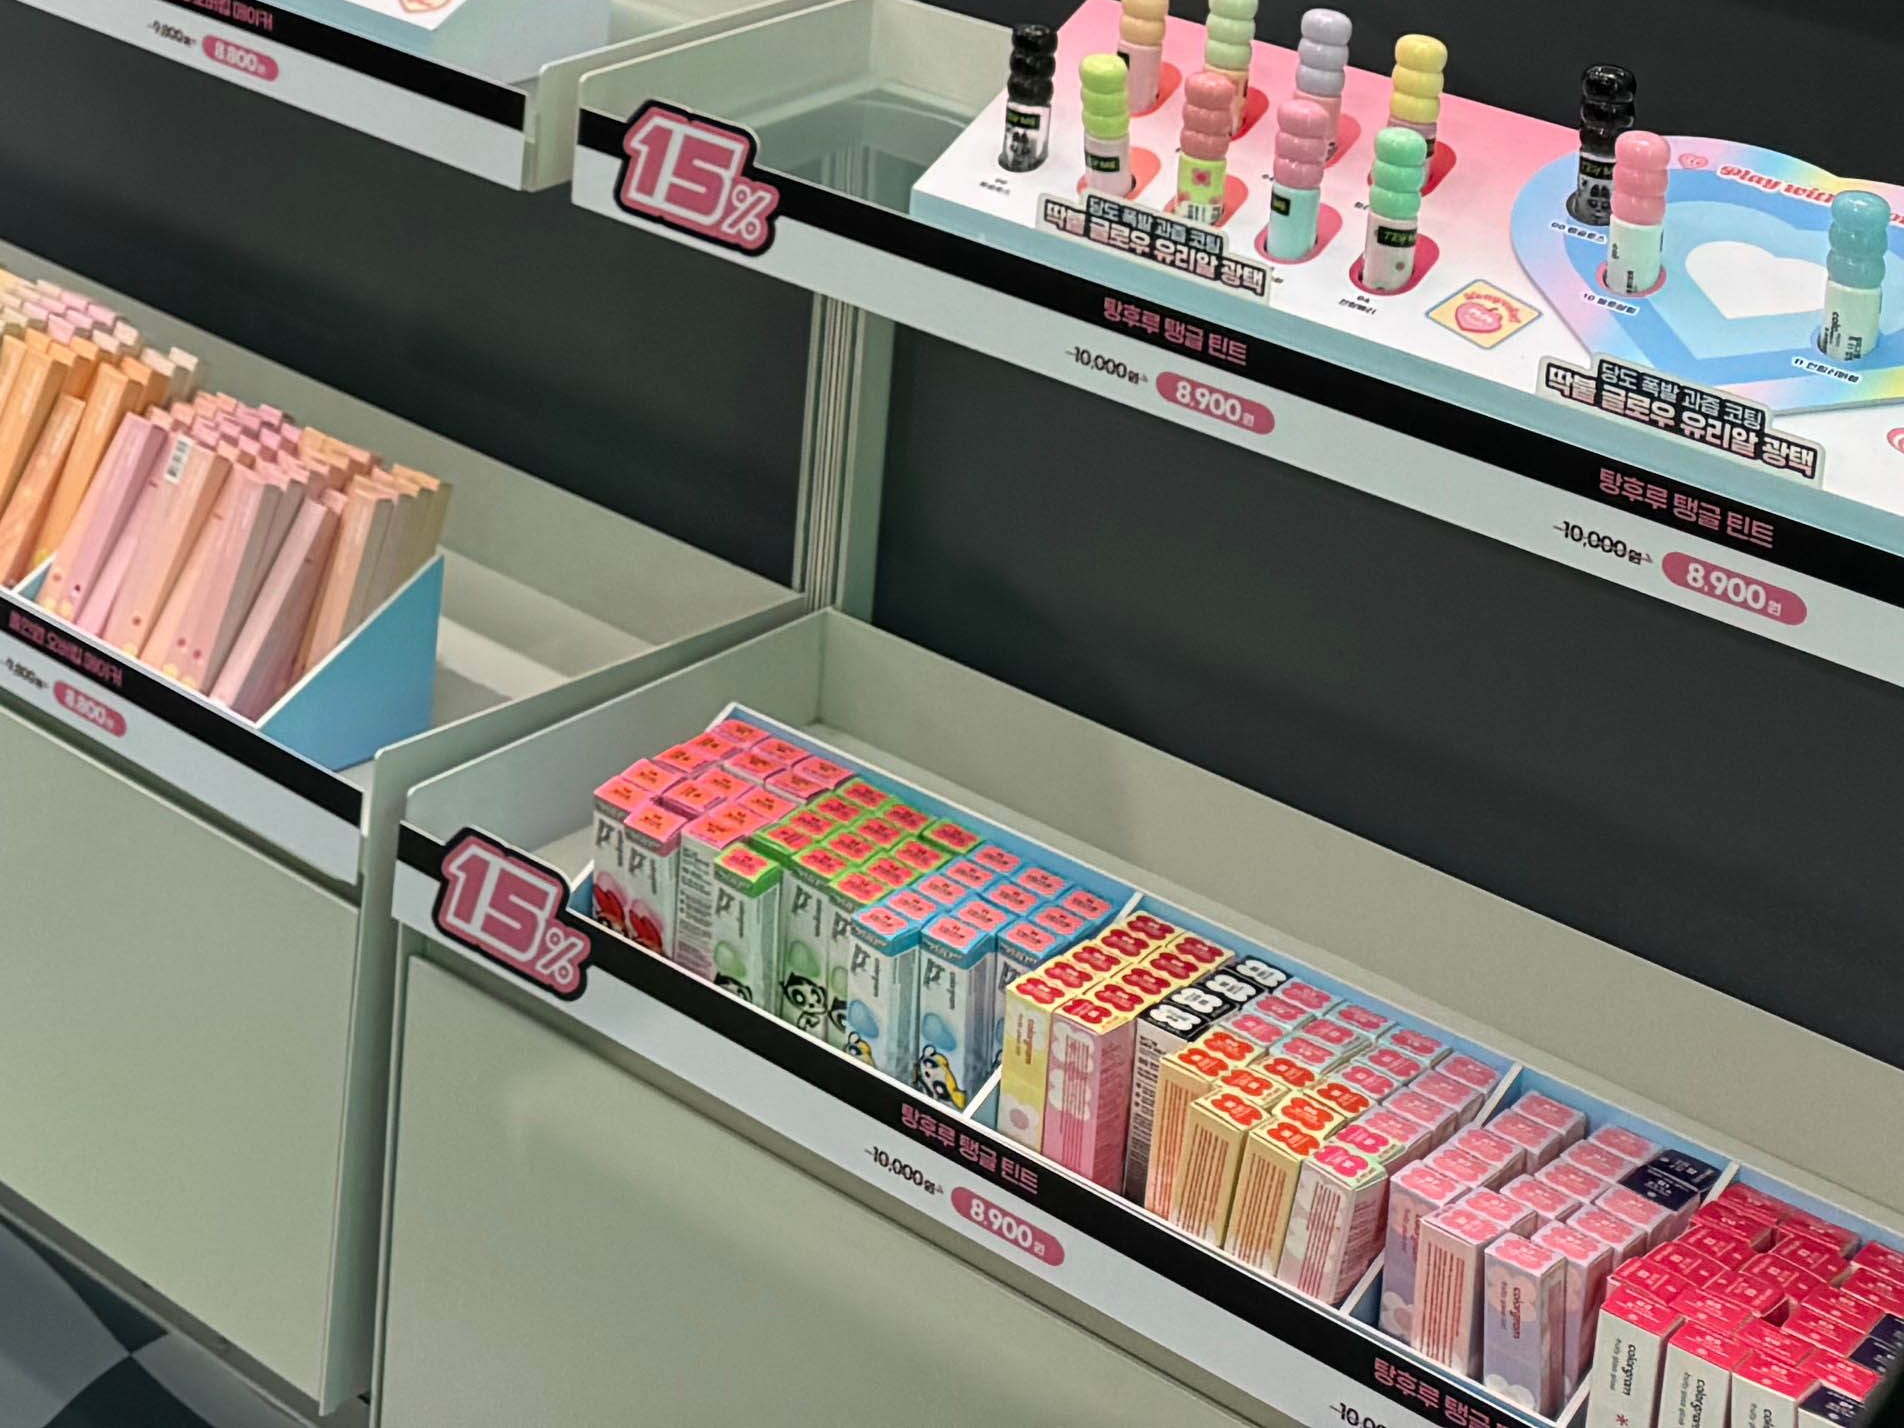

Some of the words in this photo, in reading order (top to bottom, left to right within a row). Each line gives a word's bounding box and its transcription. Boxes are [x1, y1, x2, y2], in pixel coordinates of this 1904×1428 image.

[625, 109, 780, 251] 15%
[1089, 214, 1150, 255] 글로우
[1155, 240, 1217, 280] 유리알
[1221, 262, 1266, 296] 광택
[1103, 296, 1161, 342] 탕후루
[1164, 318, 1204, 354] 탱글
[1206, 333, 1248, 367] 틴트
[1601, 362, 1639, 390] 당도
[1642, 374, 1680, 404] 폭발
[1684, 388, 1721, 418] 과즙
[1723, 402, 1763, 432] 코팅
[1601, 384, 1676, 428] 글로우
[1681, 411, 1759, 460] 유리알
[1763, 436, 1815, 477] 광택
[1600, 467, 1669, 511] 탕후루
[1673, 492, 1722, 532] 탱글
[1726, 511, 1775, 549] 틴트
[441, 838, 591, 996] 15%
[900, 1102, 956, 1148] 탕후루
[959, 1131, 997, 1172] 탱글
[1001, 1157, 1039, 1195] 틴트
[1373, 1356, 1441, 1410] 탕후루
